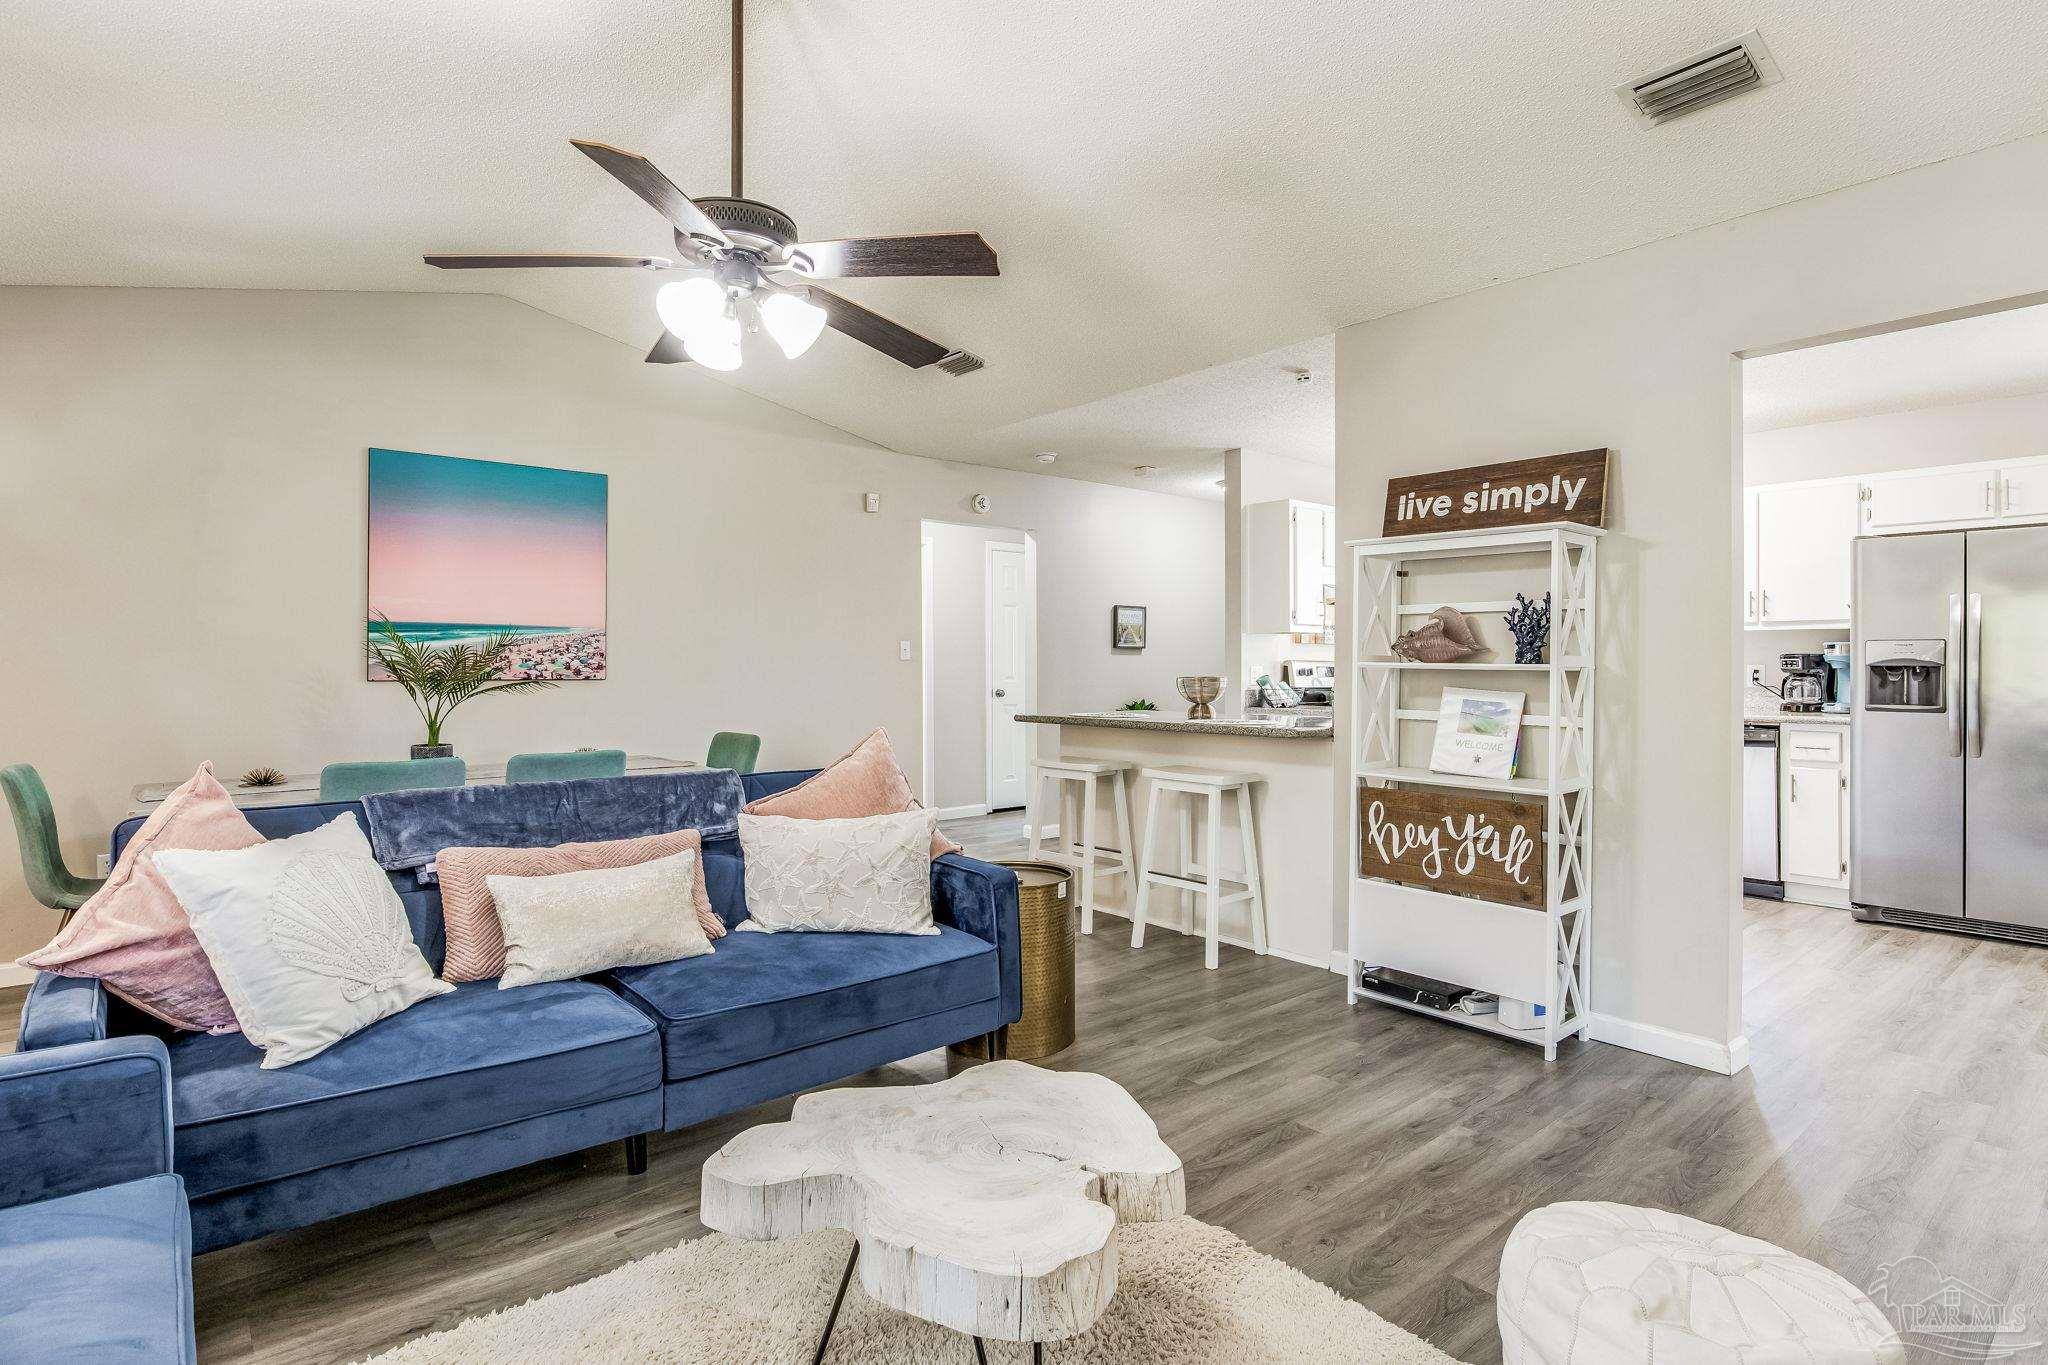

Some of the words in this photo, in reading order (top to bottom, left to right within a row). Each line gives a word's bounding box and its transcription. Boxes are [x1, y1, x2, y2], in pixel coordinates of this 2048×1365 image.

[1397, 491, 1452, 521] live
[1461, 474, 1587, 514] simply
[1455, 738, 1504, 752] WELCOME
[1368, 800, 1450, 879] hey
